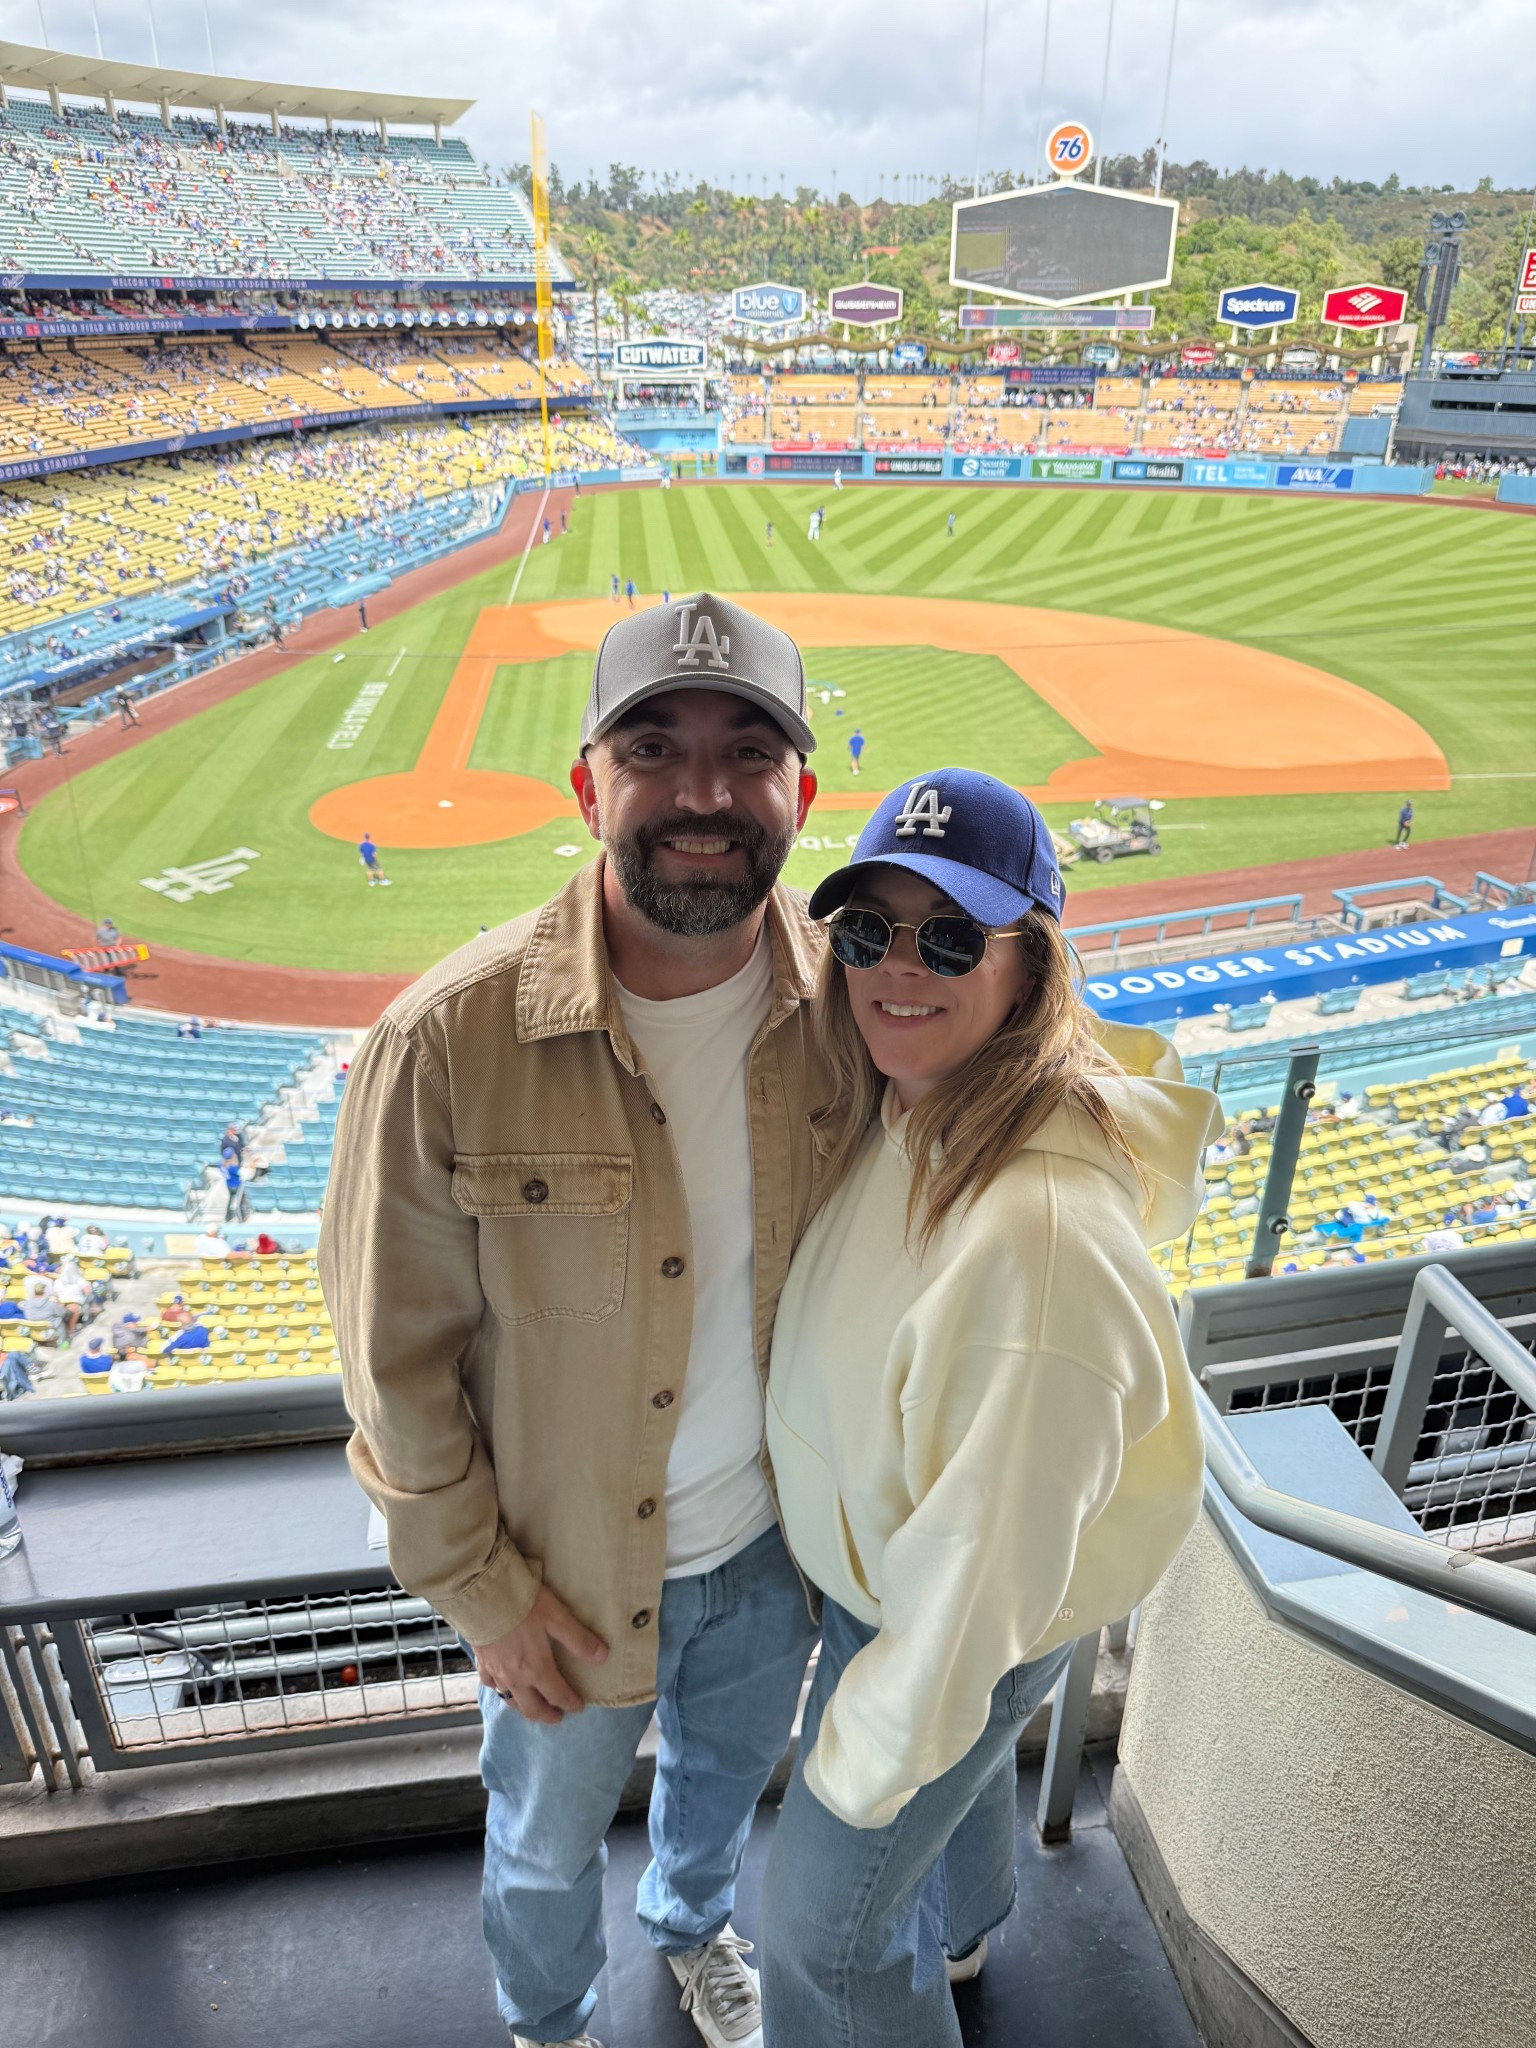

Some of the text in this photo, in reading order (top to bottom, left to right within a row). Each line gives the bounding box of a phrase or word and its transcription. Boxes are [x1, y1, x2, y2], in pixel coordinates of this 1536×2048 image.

[1056, 137, 1083, 160] 76
[111, 278, 148, 287] WELCOME
[150, 278, 161, 287] TO
[740, 291, 780, 310] blue
[1226, 298, 1286, 315] Spectrum
[10, 326, 23, 336] TO
[43, 323, 78, 335] UNIQLO
[81, 323, 104, 333] FIELD
[118, 321, 150, 331] DODGER
[620, 348, 701, 364] CUTWATER
[0, 455, 87, 478] DODGER STADIUM
[1194, 465, 1227, 481] TEL
[1291, 467, 1323, 481] ANA
[673, 603, 730, 669] LA
[895, 780, 952, 838] LA
[138, 846, 261, 903] LA
[1088, 924, 1468, 1001] DODGER STADIUM
